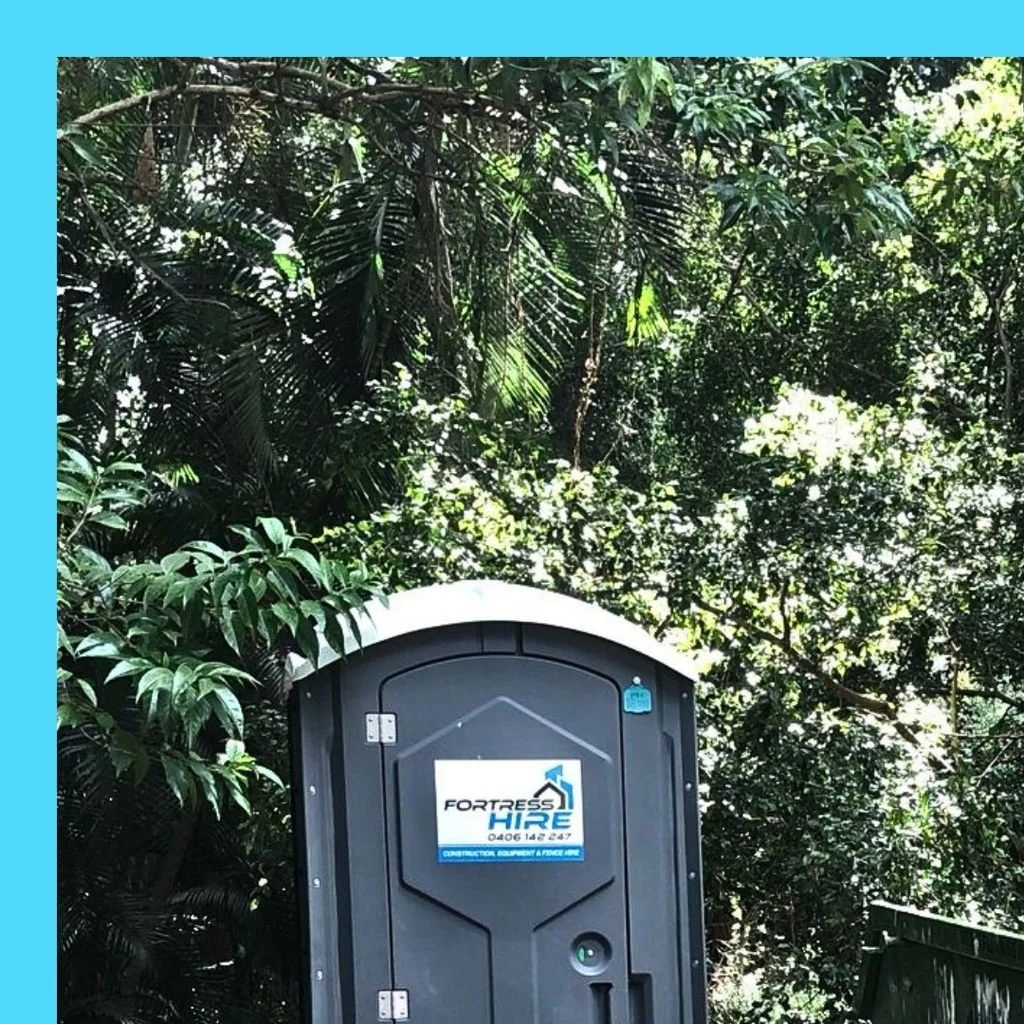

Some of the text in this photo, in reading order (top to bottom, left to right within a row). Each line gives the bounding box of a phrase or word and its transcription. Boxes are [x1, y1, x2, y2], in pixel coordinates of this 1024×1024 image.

[444, 799, 554, 811] FORTRESS
[488, 812, 573, 830] HIRE
[488, 833, 572, 841] 0406 142 247
